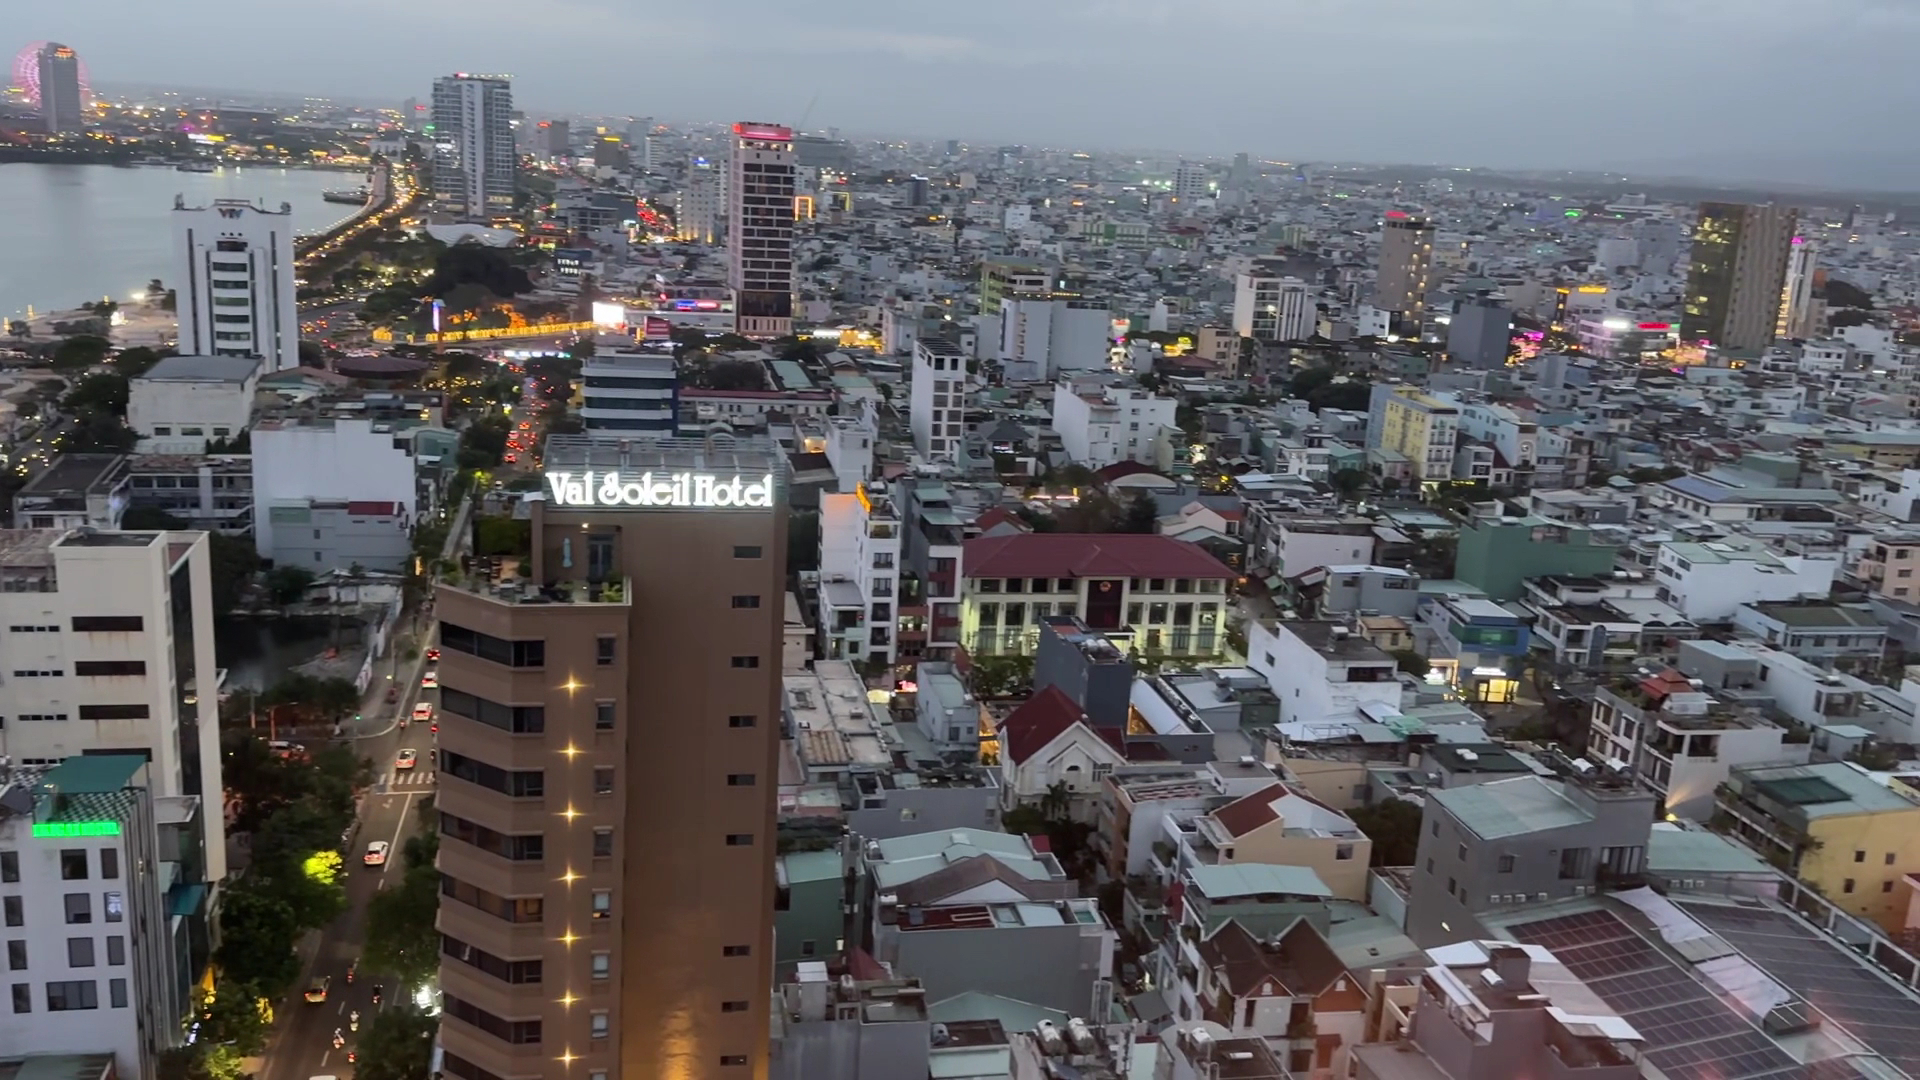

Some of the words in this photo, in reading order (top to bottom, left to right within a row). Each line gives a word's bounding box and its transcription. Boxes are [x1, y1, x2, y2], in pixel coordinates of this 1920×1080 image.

[217, 208, 243, 219] VTV
[545, 471, 594, 505] Val
[598, 471, 690, 506] Soleil
[693, 474, 773, 507] Hotel
